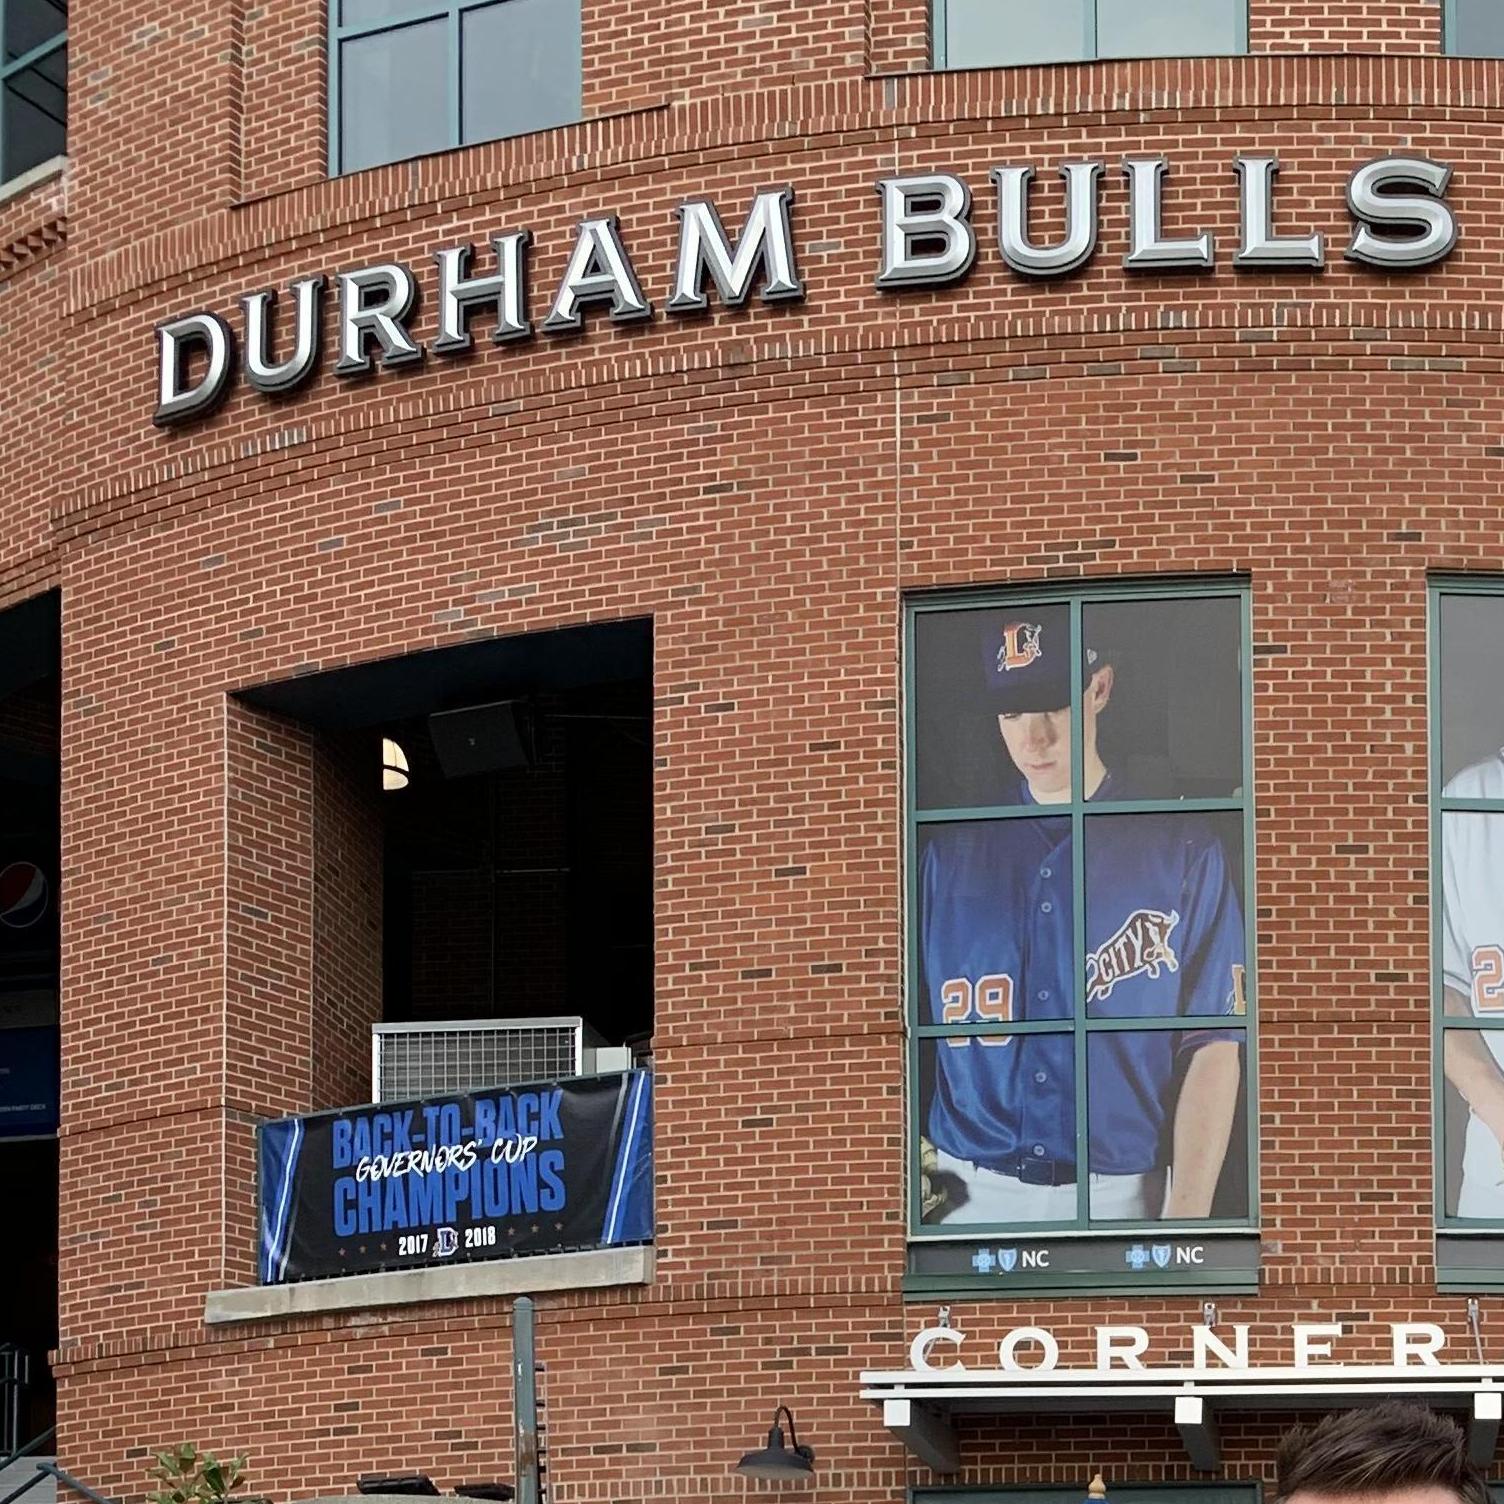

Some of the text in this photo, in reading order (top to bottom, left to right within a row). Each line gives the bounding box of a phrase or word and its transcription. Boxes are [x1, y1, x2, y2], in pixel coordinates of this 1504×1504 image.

[152, 183, 806, 427] DURHAM
[874, 153, 1460, 290] BULLS
[1099, 918, 1143, 983] CITY
[941, 973, 1014, 1047] 29
[332, 1088, 565, 1169] BACK-TO-BACK
[355, 1134, 538, 1183] GOVERNORS' CUP
[333, 1150, 566, 1238] CHAMPIONS
[398, 1233, 429, 1257] 2017
[465, 1226, 496, 1248] 2018
[1022, 1250, 1049, 1267] NC
[1176, 1246, 1204, 1264] NC
[909, 1321, 1450, 1373] CORNER
